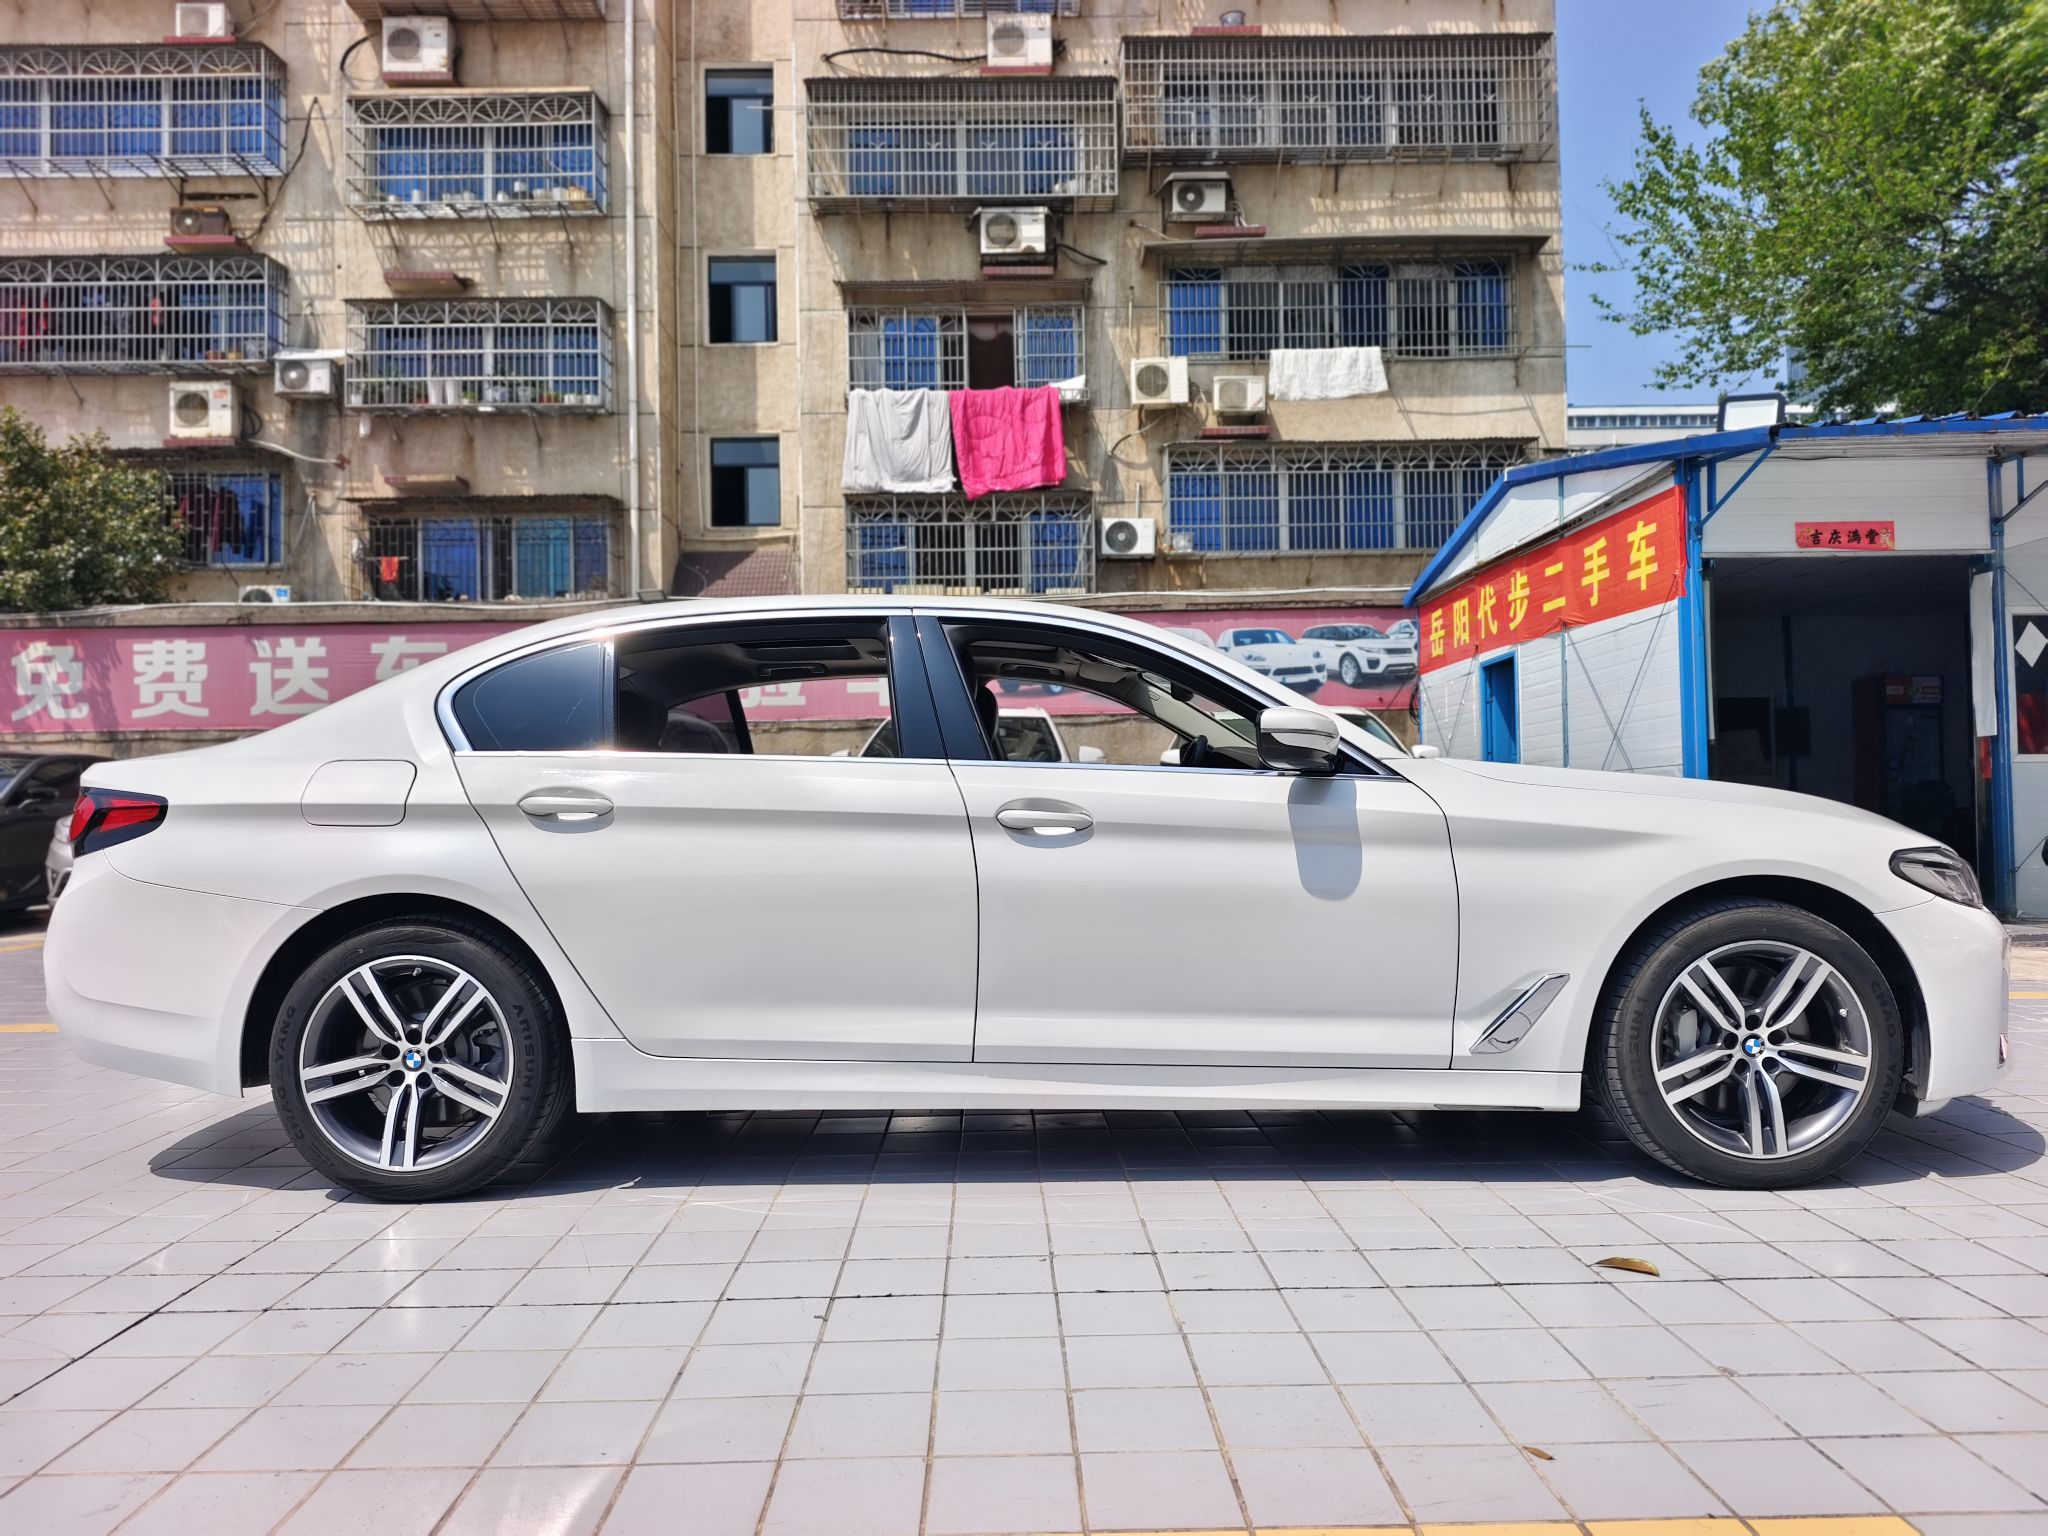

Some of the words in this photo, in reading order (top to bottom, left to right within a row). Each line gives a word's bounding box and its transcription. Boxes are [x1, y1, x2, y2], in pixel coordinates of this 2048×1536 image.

[1810, 528, 1880, 545] 吉庆满堂
[1429, 520, 1658, 657] 岳阳代步二手车
[275, 1004, 297, 1065] YANG
[511, 1003, 536, 1088] ARISUN
